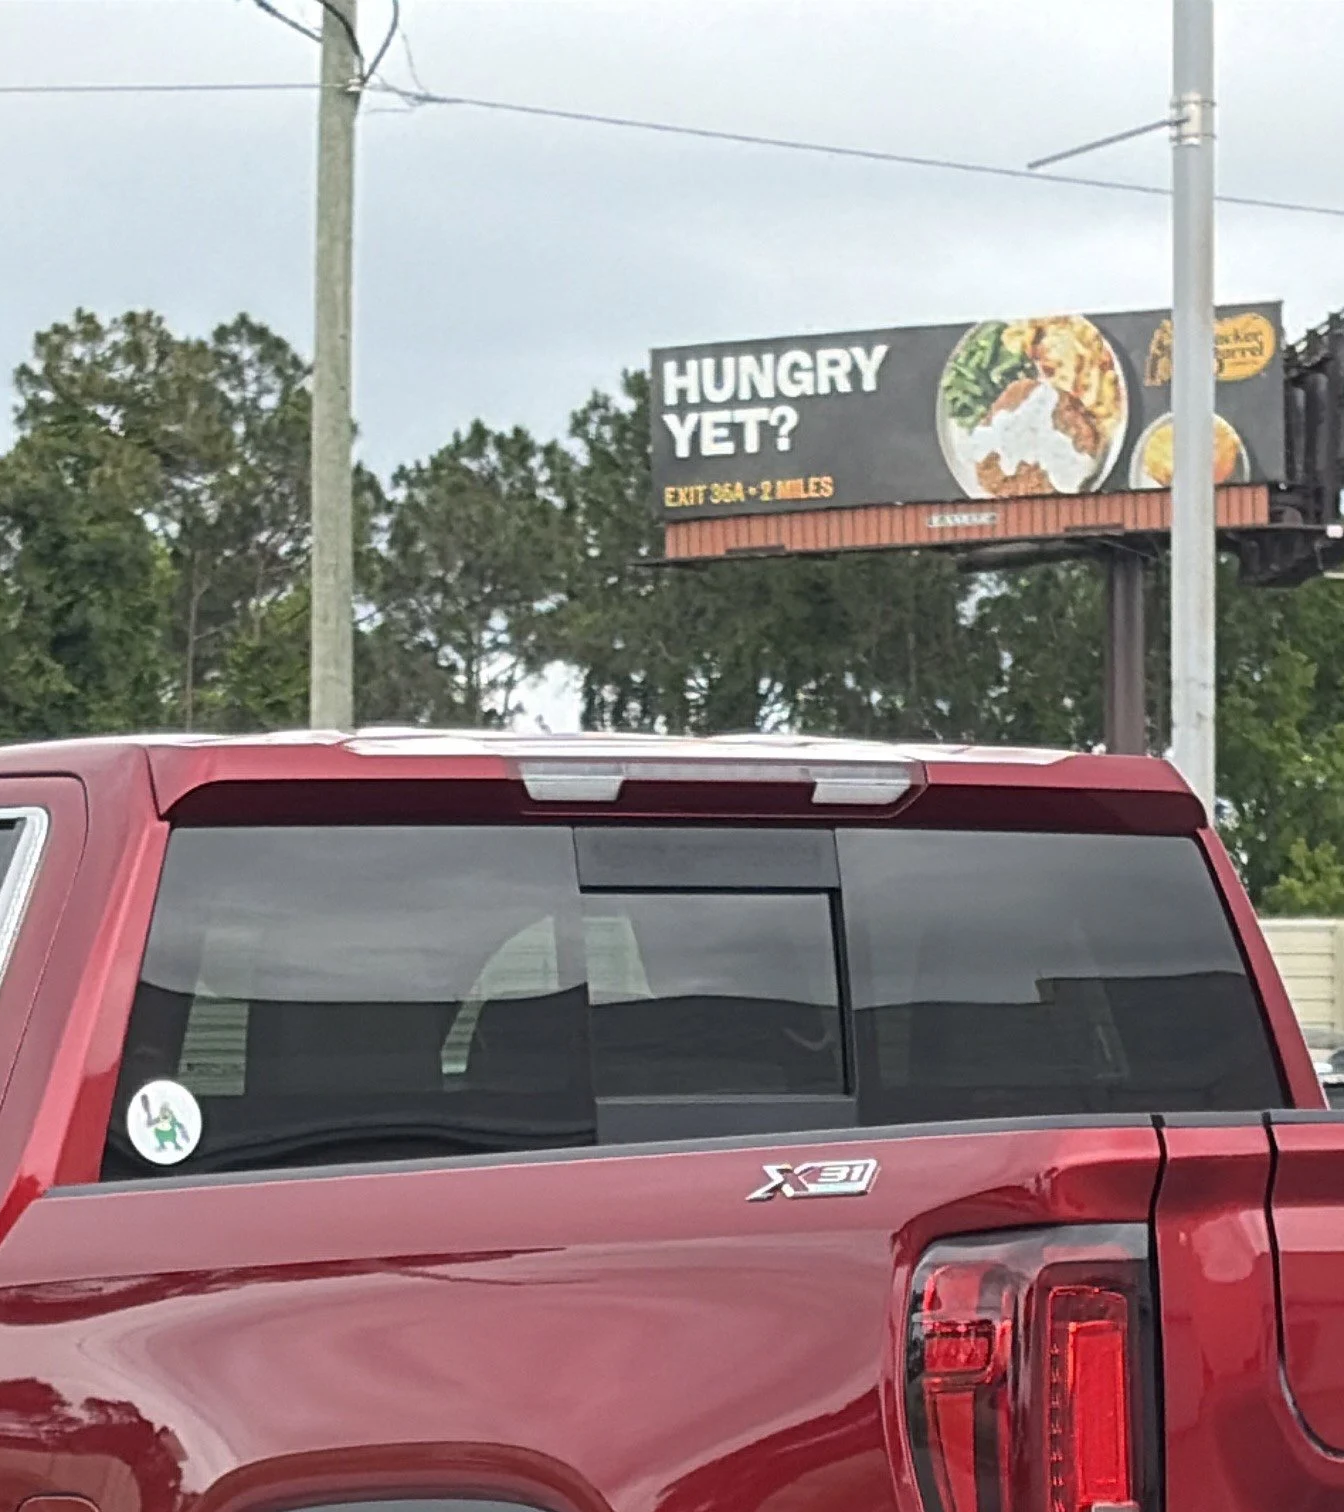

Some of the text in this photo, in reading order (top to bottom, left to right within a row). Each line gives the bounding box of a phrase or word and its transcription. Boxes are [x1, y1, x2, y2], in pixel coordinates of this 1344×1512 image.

[663, 344, 889, 406] HUNGRY
[662, 405, 799, 458] YET?
[664, 484, 706, 507] EXIT
[760, 480, 774, 501] 2
[775, 475, 834, 500] MILES
[745, 1158, 878, 1202] X31
